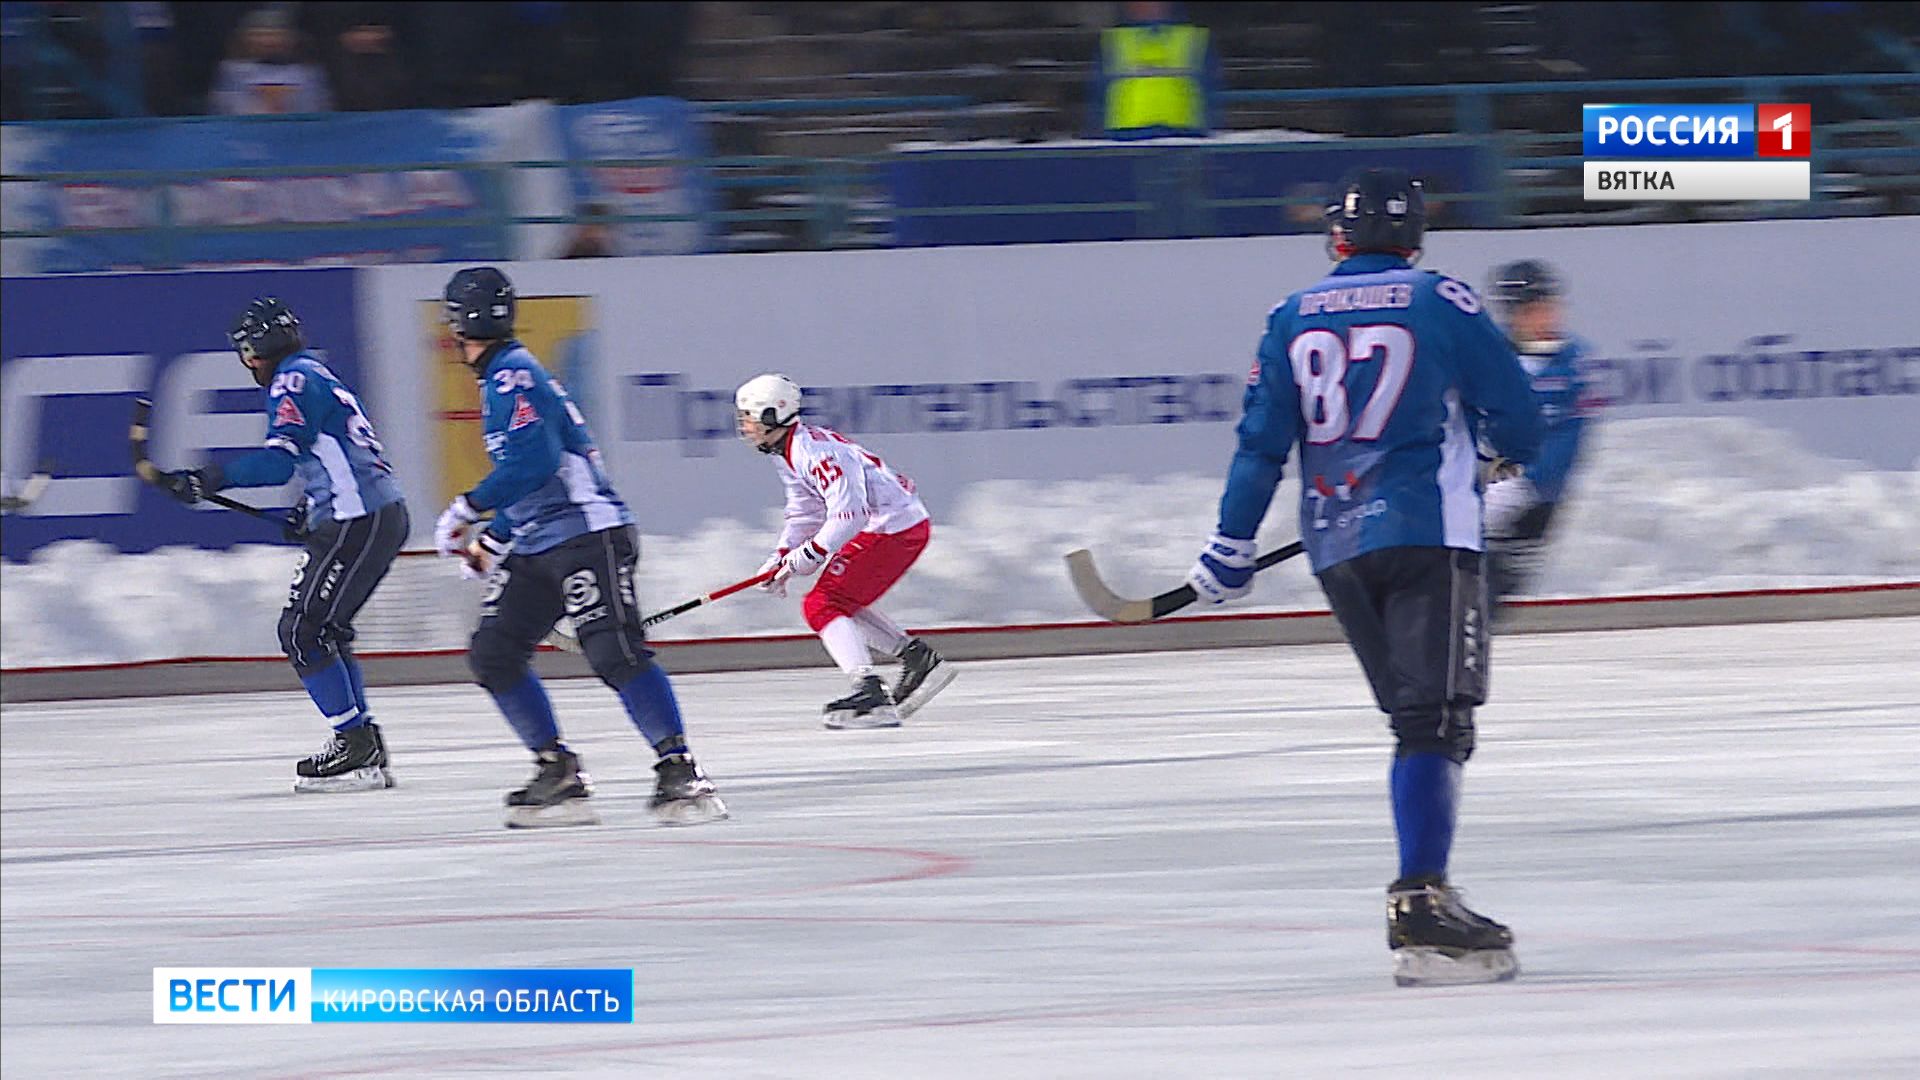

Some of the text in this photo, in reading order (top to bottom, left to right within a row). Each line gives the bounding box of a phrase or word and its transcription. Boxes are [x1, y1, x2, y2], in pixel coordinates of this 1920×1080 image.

[493, 368, 536, 395] 34
[1287, 321, 1416, 446] 87
[617, 371, 1238, 459] Првительство
[811, 457, 843, 491] 35
